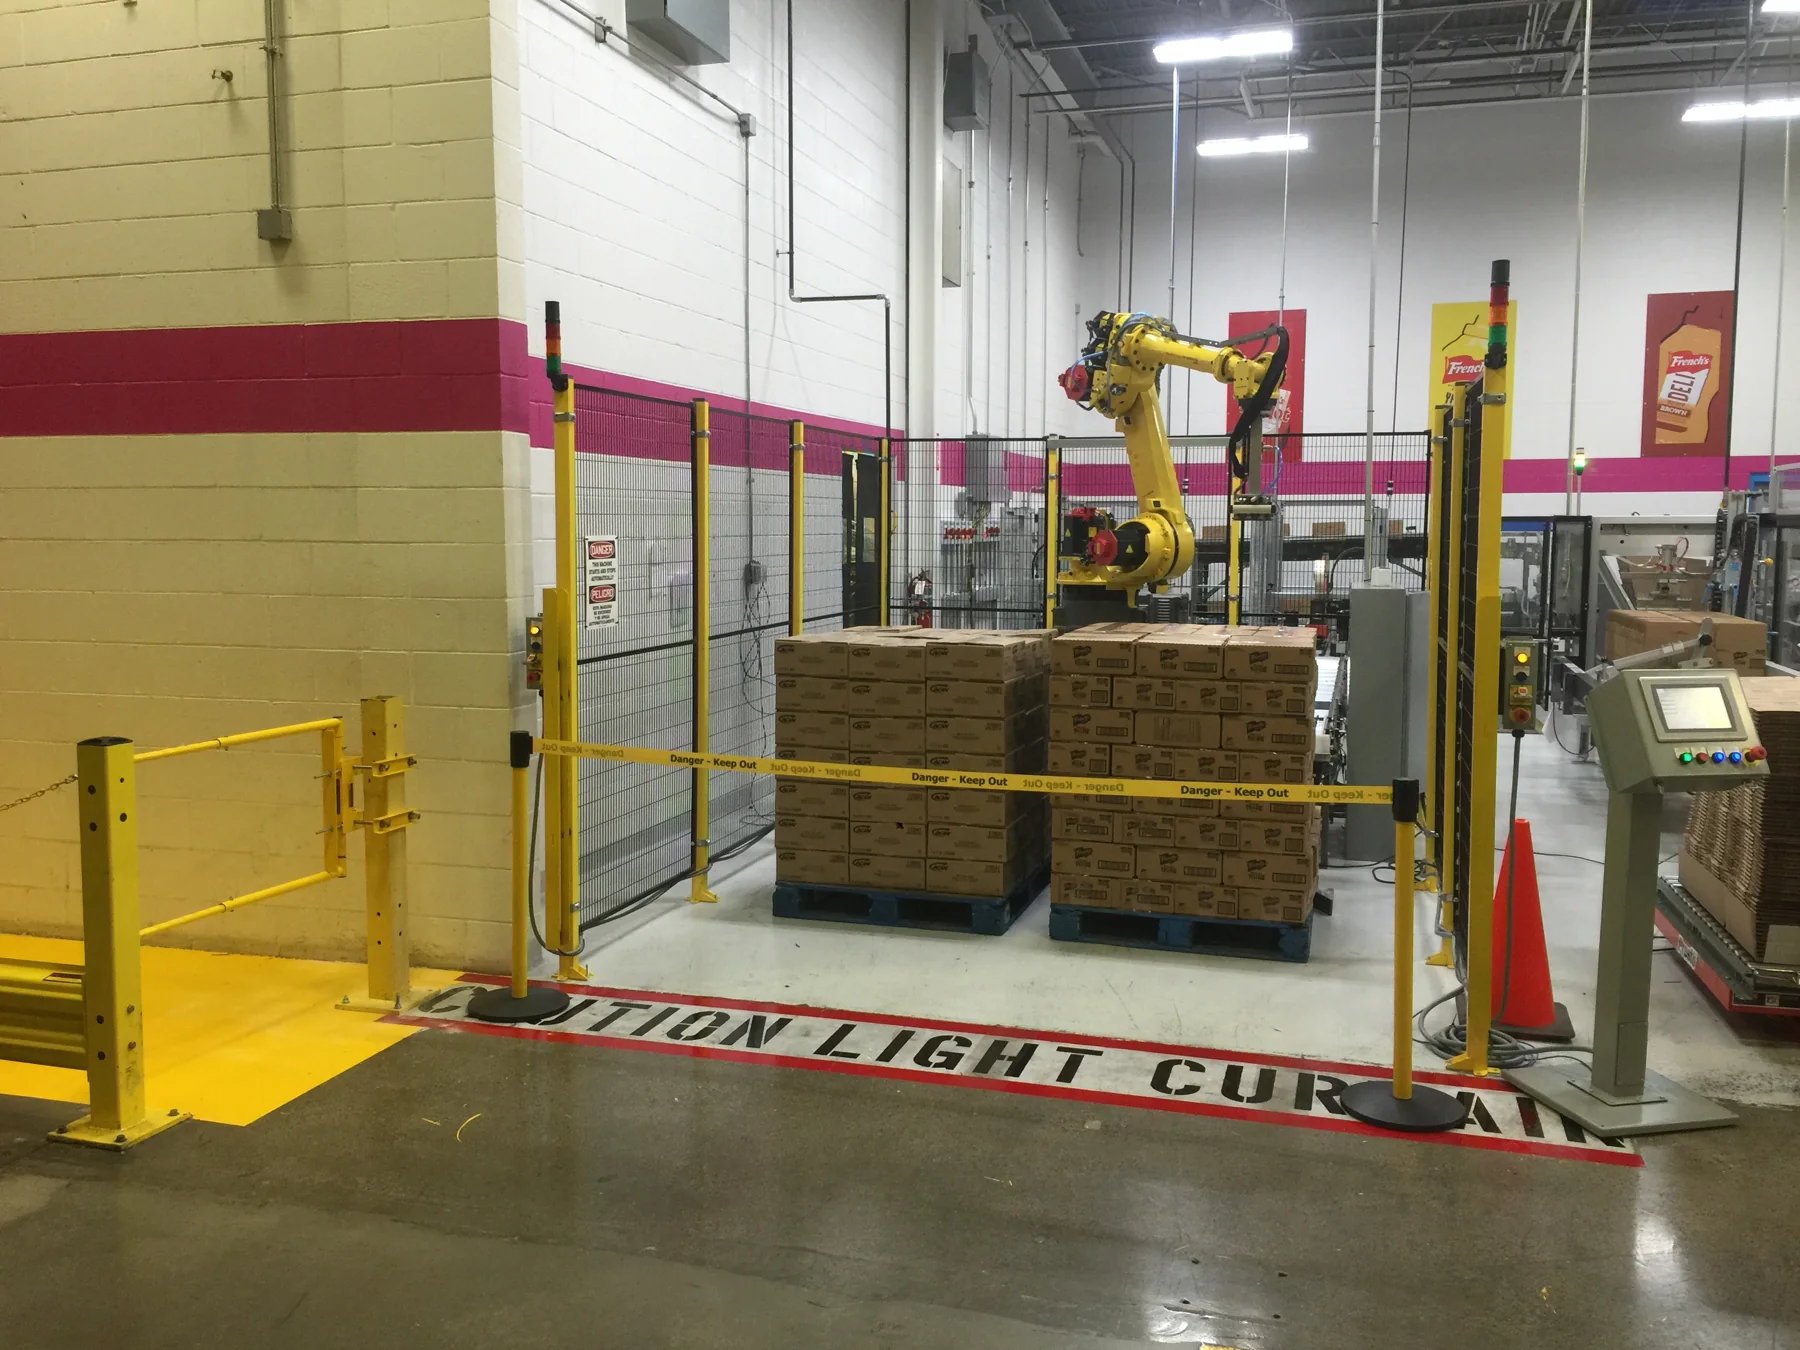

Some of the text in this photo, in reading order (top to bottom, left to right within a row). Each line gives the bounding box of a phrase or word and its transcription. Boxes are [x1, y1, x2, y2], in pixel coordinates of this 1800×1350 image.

[1670, 355, 1710, 367] French's
[1668, 373, 1695, 402] DELI
[1660, 405, 1688, 416] BROWN
[591, 545, 613, 555] DANGER
[592, 589, 613, 599] PELIGRO
[670, 754, 704, 766] Danger
[713, 758, 737, 769] Keep
[740, 760, 757, 770] Out
[912, 772, 949, 785] Danger
[959, 775, 985, 787] Keep
[988, 777, 1008, 786] Out
[1180, 785, 1223, 798] Danger
[1234, 787, 1264, 799] Keep
[1267, 788, 1289, 798] Out
[418, 986, 1625, 1148] CUTION LIGHT CURAI
